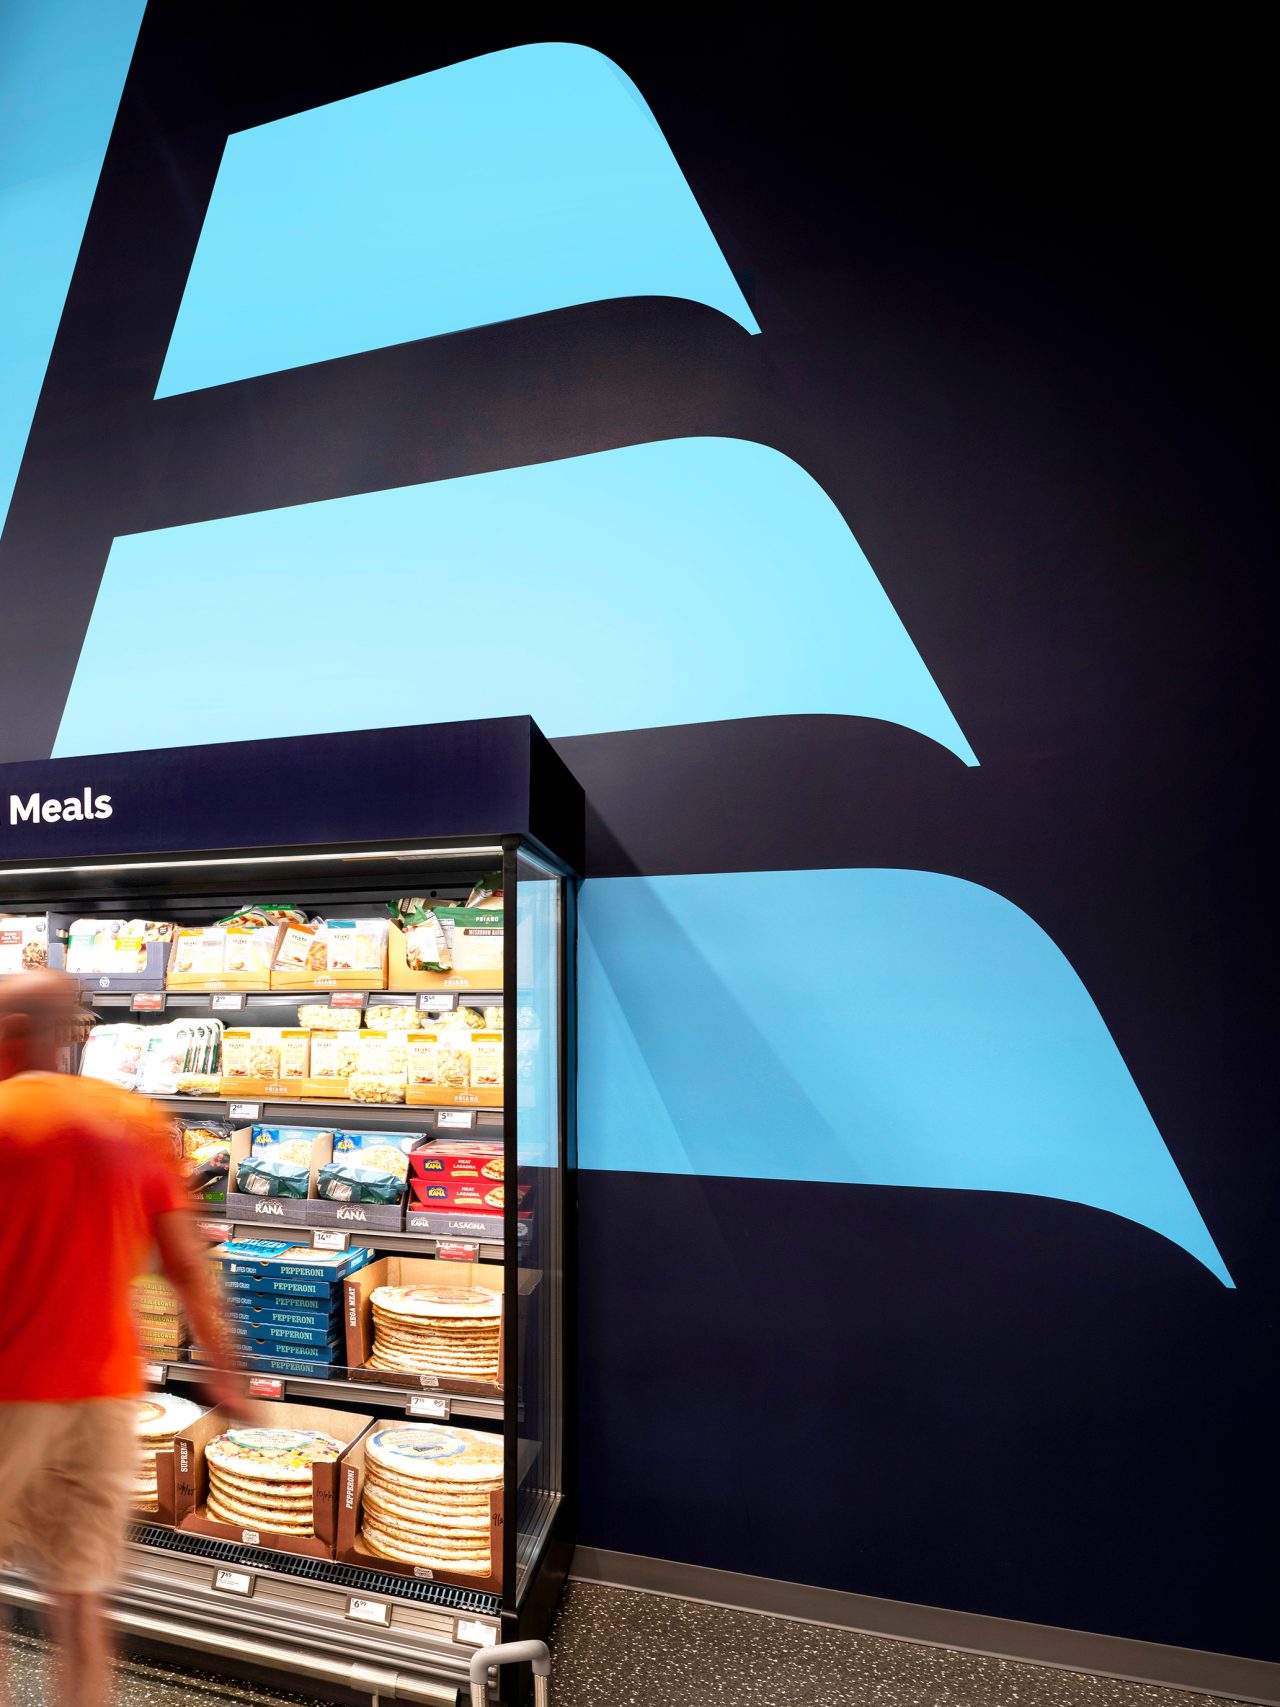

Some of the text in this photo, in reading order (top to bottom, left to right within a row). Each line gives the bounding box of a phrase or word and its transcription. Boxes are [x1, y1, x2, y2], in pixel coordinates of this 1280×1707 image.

[9, 786, 113, 826] Meals
[428, 1189, 446, 1197] RANA
[255, 1204, 284, 1216] RANA
[336, 1209, 367, 1221] RANA
[411, 1219, 429, 1228] RANA
[448, 1221, 486, 1230] LASAGNA
[280, 1266, 324, 1277] PEPPERONI
[273, 1282, 316, 1293] PEPPERONI
[275, 1297, 319, 1309] PEPPERONI
[348, 1287, 356, 1307] MEAT
[272, 1313, 315, 1325] PEPPERONI
[349, 1308, 357, 1327] MEGA
[270, 1328, 313, 1340] PEPPERONI
[275, 1345, 319, 1356] PEPPERONI
[271, 1360, 314, 1373] PEPPERONI
[345, 1469, 355, 1510] PEPPERONI
